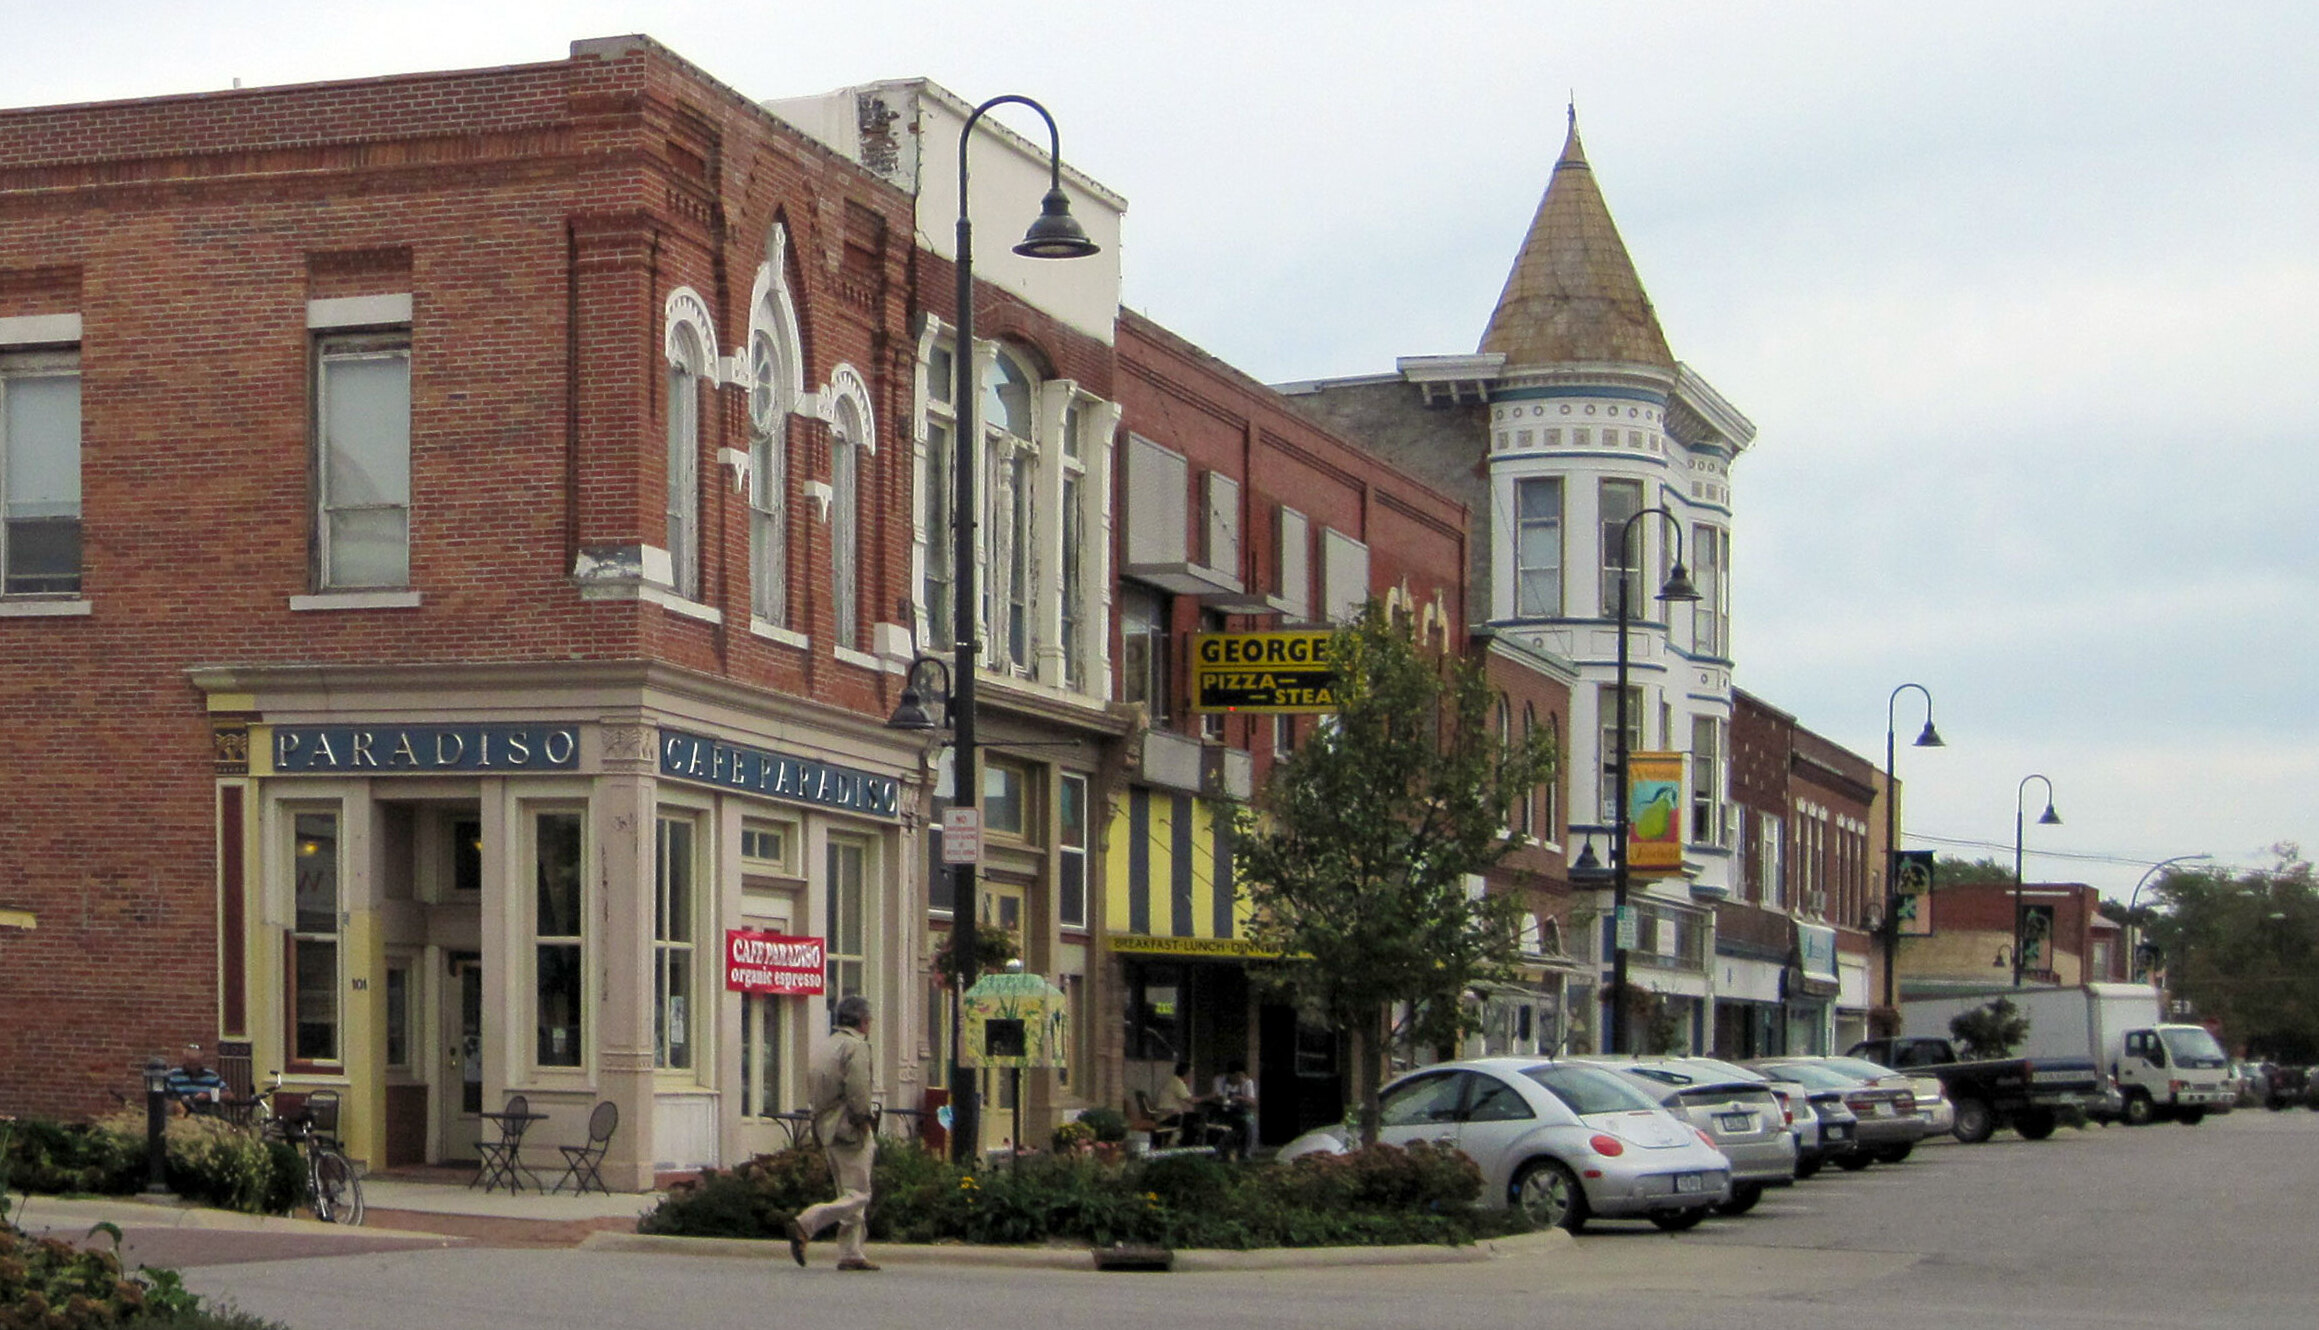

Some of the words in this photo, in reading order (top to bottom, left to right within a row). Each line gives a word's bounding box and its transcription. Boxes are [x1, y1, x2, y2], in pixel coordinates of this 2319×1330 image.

[1201, 638, 1329, 663] GEORGE
[1274, 688, 1333, 704] STEA
[277, 731, 574, 766] PARADISO
[667, 737, 745, 783] CAFE
[759, 756, 896, 813] PARADISO
[733, 938, 764, 963] CAFE
[764, 941, 820, 968] PARADISO
[1231, 941, 1279, 955] DINNE
[352, 978, 367, 991] 101
[731, 966, 773, 988] organic
[774, 971, 821, 990] espresso
